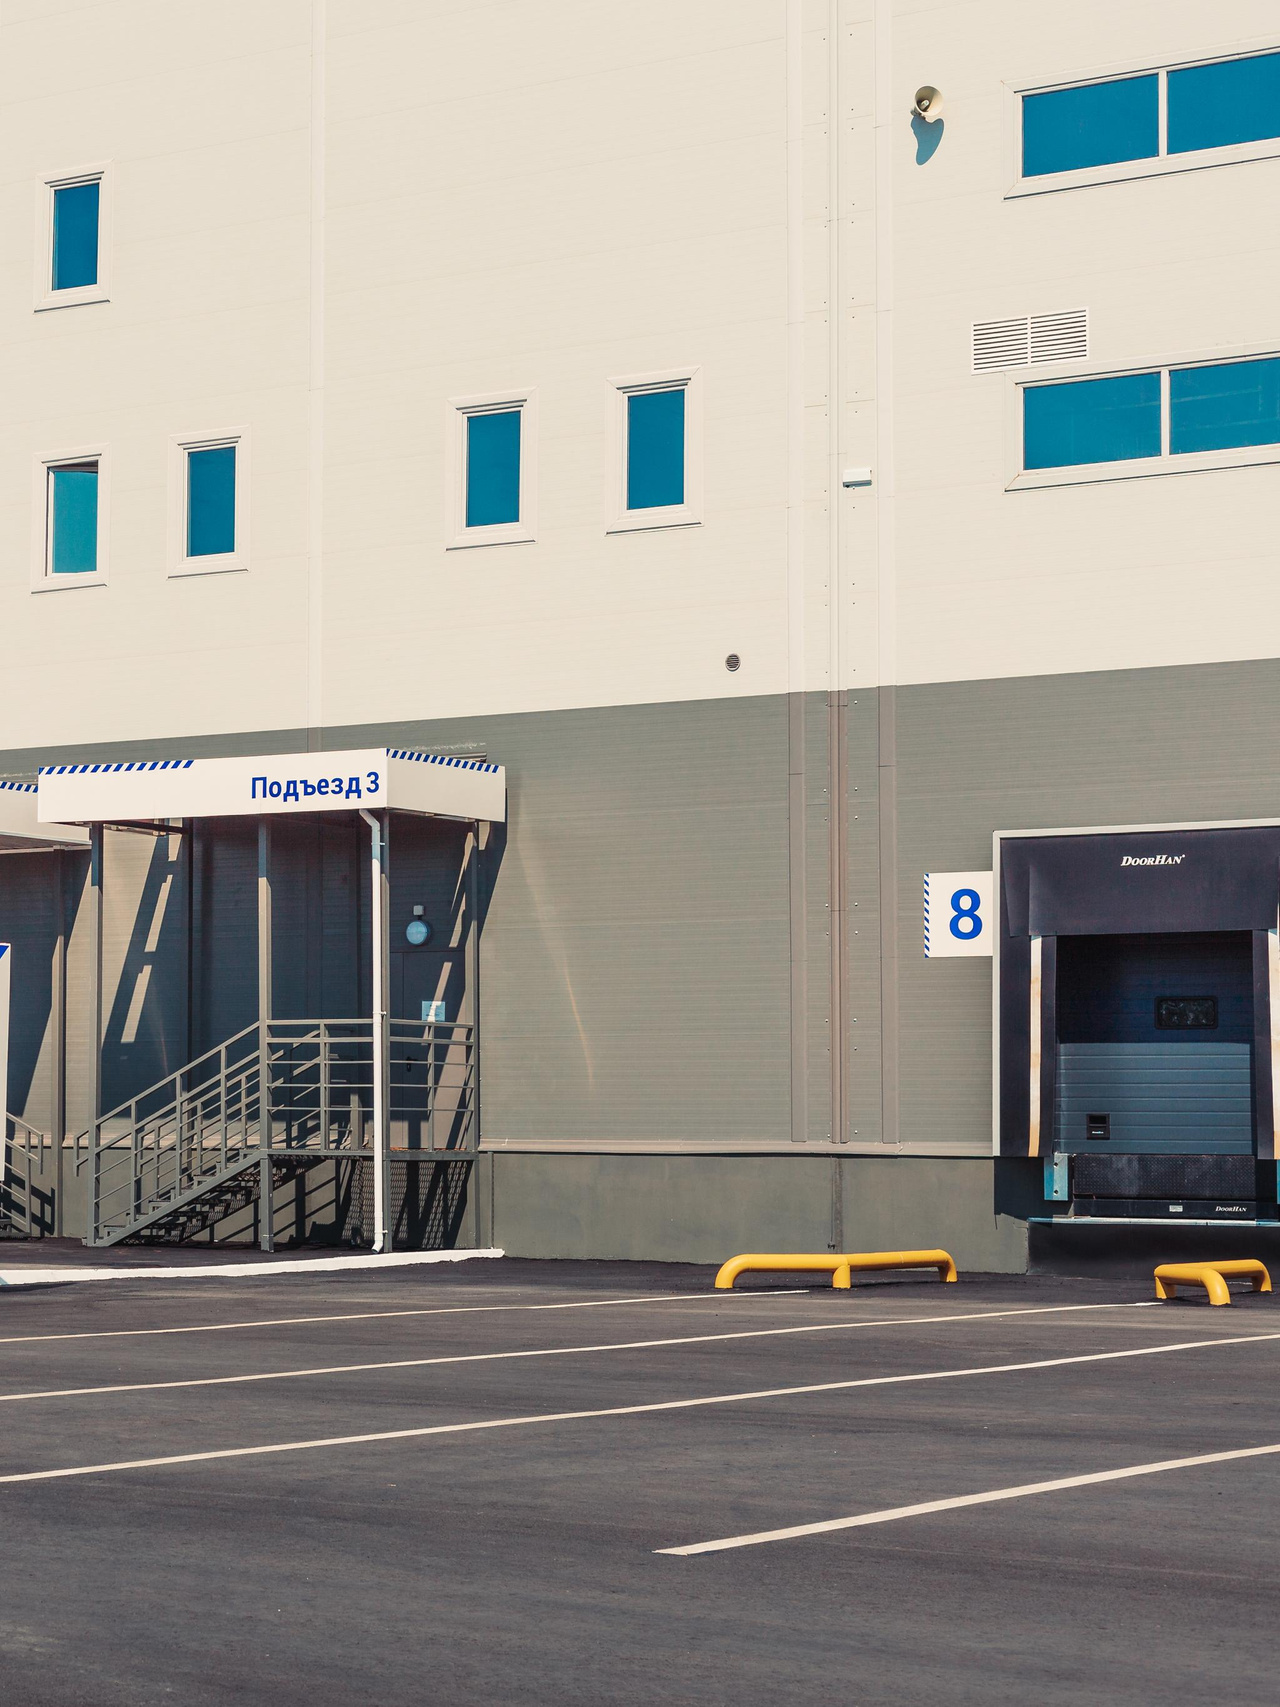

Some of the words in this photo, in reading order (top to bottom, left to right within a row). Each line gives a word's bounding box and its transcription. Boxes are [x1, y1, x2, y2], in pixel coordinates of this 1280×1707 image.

[251, 776, 362, 802] Подъезд
[366, 771, 380, 793] 3
[949, 888, 983, 941] 8
